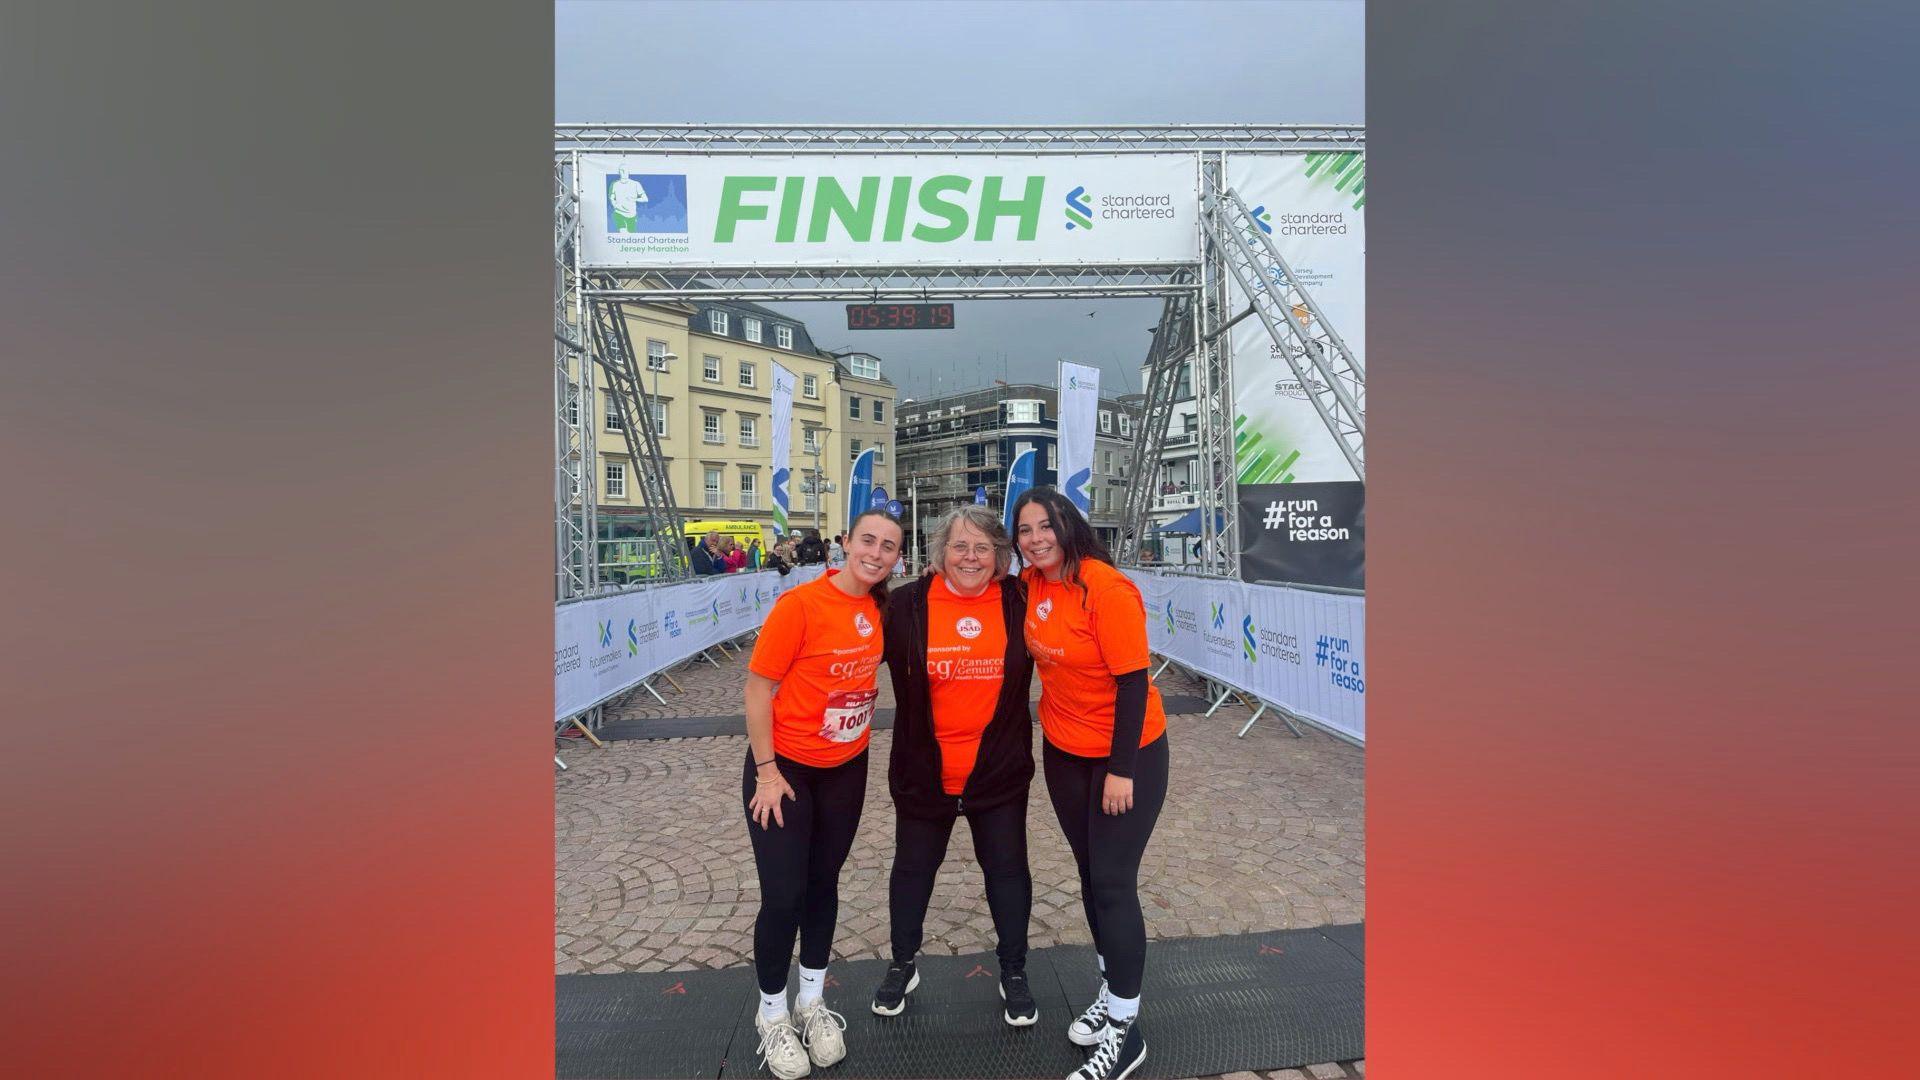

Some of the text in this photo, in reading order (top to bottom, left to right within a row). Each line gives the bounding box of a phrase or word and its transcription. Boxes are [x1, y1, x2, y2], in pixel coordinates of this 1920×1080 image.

[1102, 194, 1170, 206] standard
[714, 175, 1046, 243] FINISH
[1102, 206, 1175, 219] chartered
[1281, 212, 1343, 224] standard
[1281, 224, 1347, 235] chartered
[607, 236, 689, 244] Standard Chartered
[619, 245, 689, 254] Jersey Marathon
[1288, 512, 1332, 528] for a
[1290, 528, 1349, 541] reason
[1260, 628, 1297, 648] standard
[1261, 642, 1300, 665] chartered
[1331, 651, 1359, 676] for a
[958, 666, 1000, 675] Genuity
